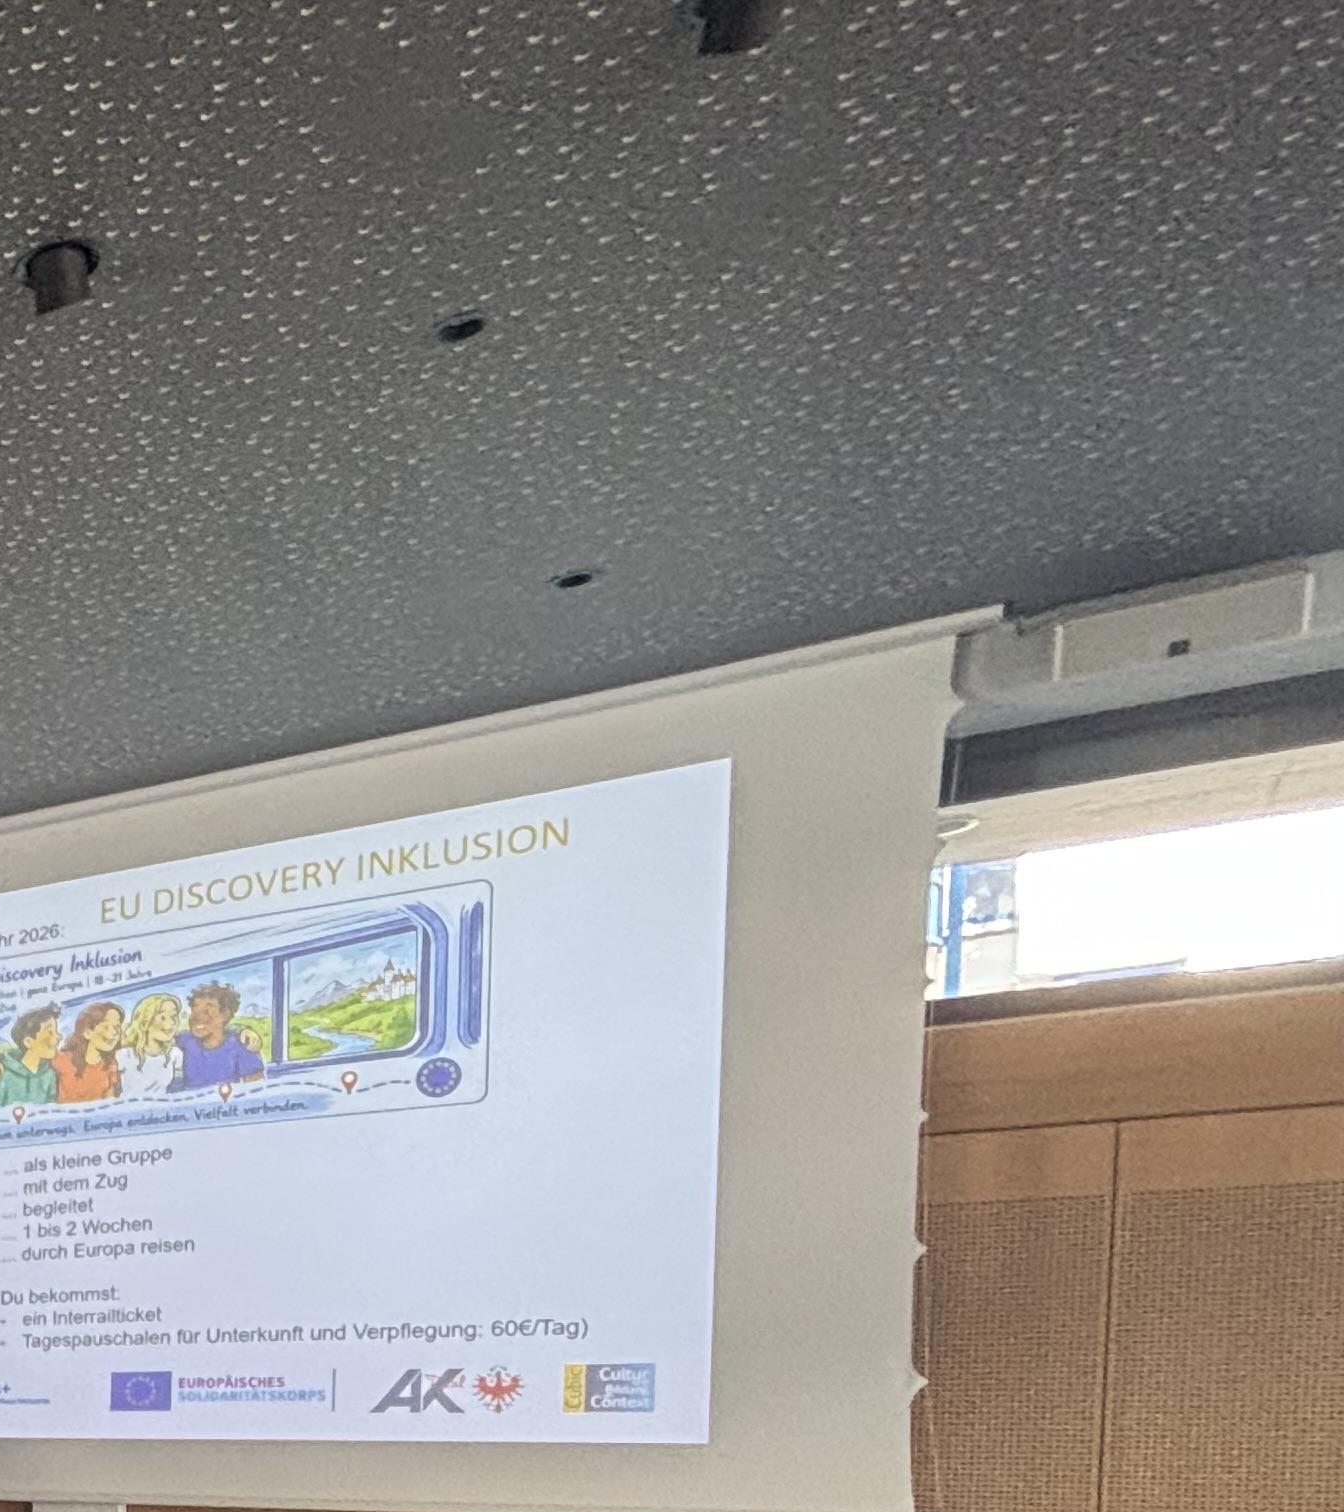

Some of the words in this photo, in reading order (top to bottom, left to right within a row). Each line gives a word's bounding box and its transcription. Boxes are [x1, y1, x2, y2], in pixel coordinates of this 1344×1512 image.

[100, 893, 141, 924] EU
[154, 857, 345, 915] DISCOVERY
[358, 817, 571, 881] INKLUSION
[19, 923, 64, 945] 2026:
[70, 949, 143, 973] Inklusion
[24, 1157, 47, 1173] als
[53, 1153, 102, 1170] kleine
[107, 1148, 173, 1167] Gruppe
[23, 1178, 48, 1196] mit
[53, 1176, 89, 1193] dem
[95, 1173, 128, 1192] Zug
[23, 1197, 94, 1220] begleitet
[23, 1223, 31, 1240] 1
[38, 1222, 61, 1239] bis
[66, 1220, 77, 1237] 2
[82, 1217, 153, 1235] Wochen
[21, 1245, 68, 1262] durch
[74, 1242, 135, 1260] Europa
[141, 1239, 196, 1255] reisen
[0, 1290, 24, 1306] Du
[29, 1285, 120, 1304] bekommst:
[22, 1311, 47, 1327] ein
[53, 1307, 162, 1326] Interrailticket
[22, 1330, 171, 1351] Tagespauschalen
[177, 1328, 201, 1345] für
[206, 1325, 304, 1344] Unterkunft
[311, 1324, 346, 1341] und
[352, 1322, 483, 1344] Verpflegung:
[490, 1318, 589, 1340] 60€/Tag)
[177, 1374, 285, 1388] EUROPÄISCHES
[369, 1368, 465, 1413] AK
